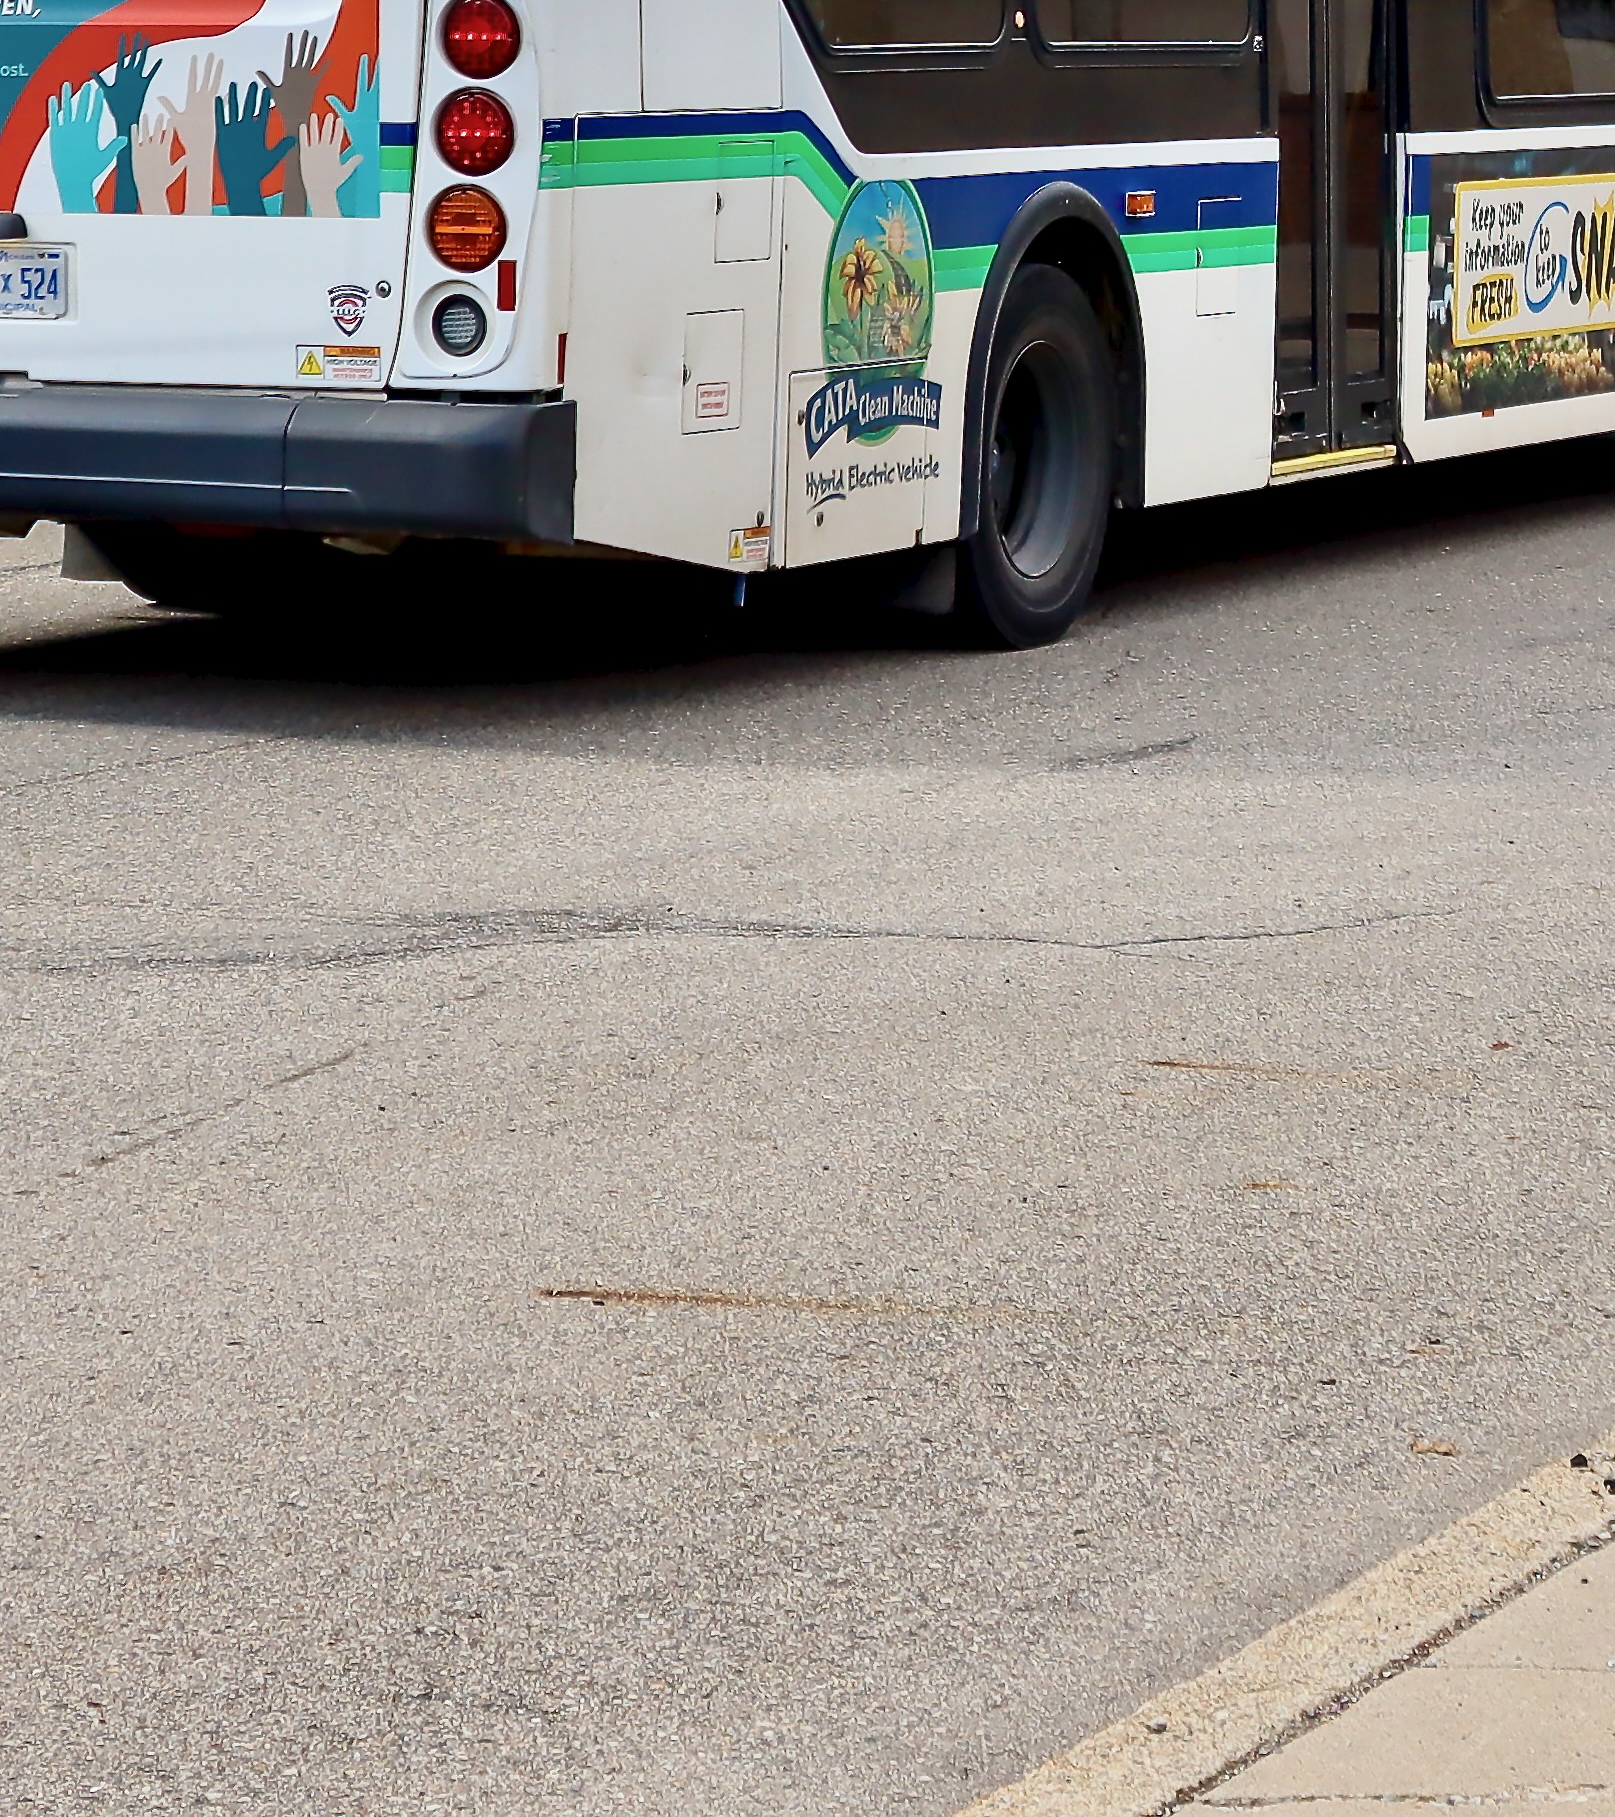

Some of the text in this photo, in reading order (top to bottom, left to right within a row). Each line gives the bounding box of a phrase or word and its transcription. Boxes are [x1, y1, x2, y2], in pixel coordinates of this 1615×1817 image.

[1471, 198, 1524, 241] Keep your
[1539, 223, 1551, 255] to
[1464, 234, 1526, 273] information
[1535, 253, 1557, 289] keep
[19, 267, 59, 300] 524
[1470, 278, 1515, 324] FRESH
[810, 378, 937, 444] CATA Clean Machine
[805, 453, 940, 503] Hybrid Electric Vehicle
